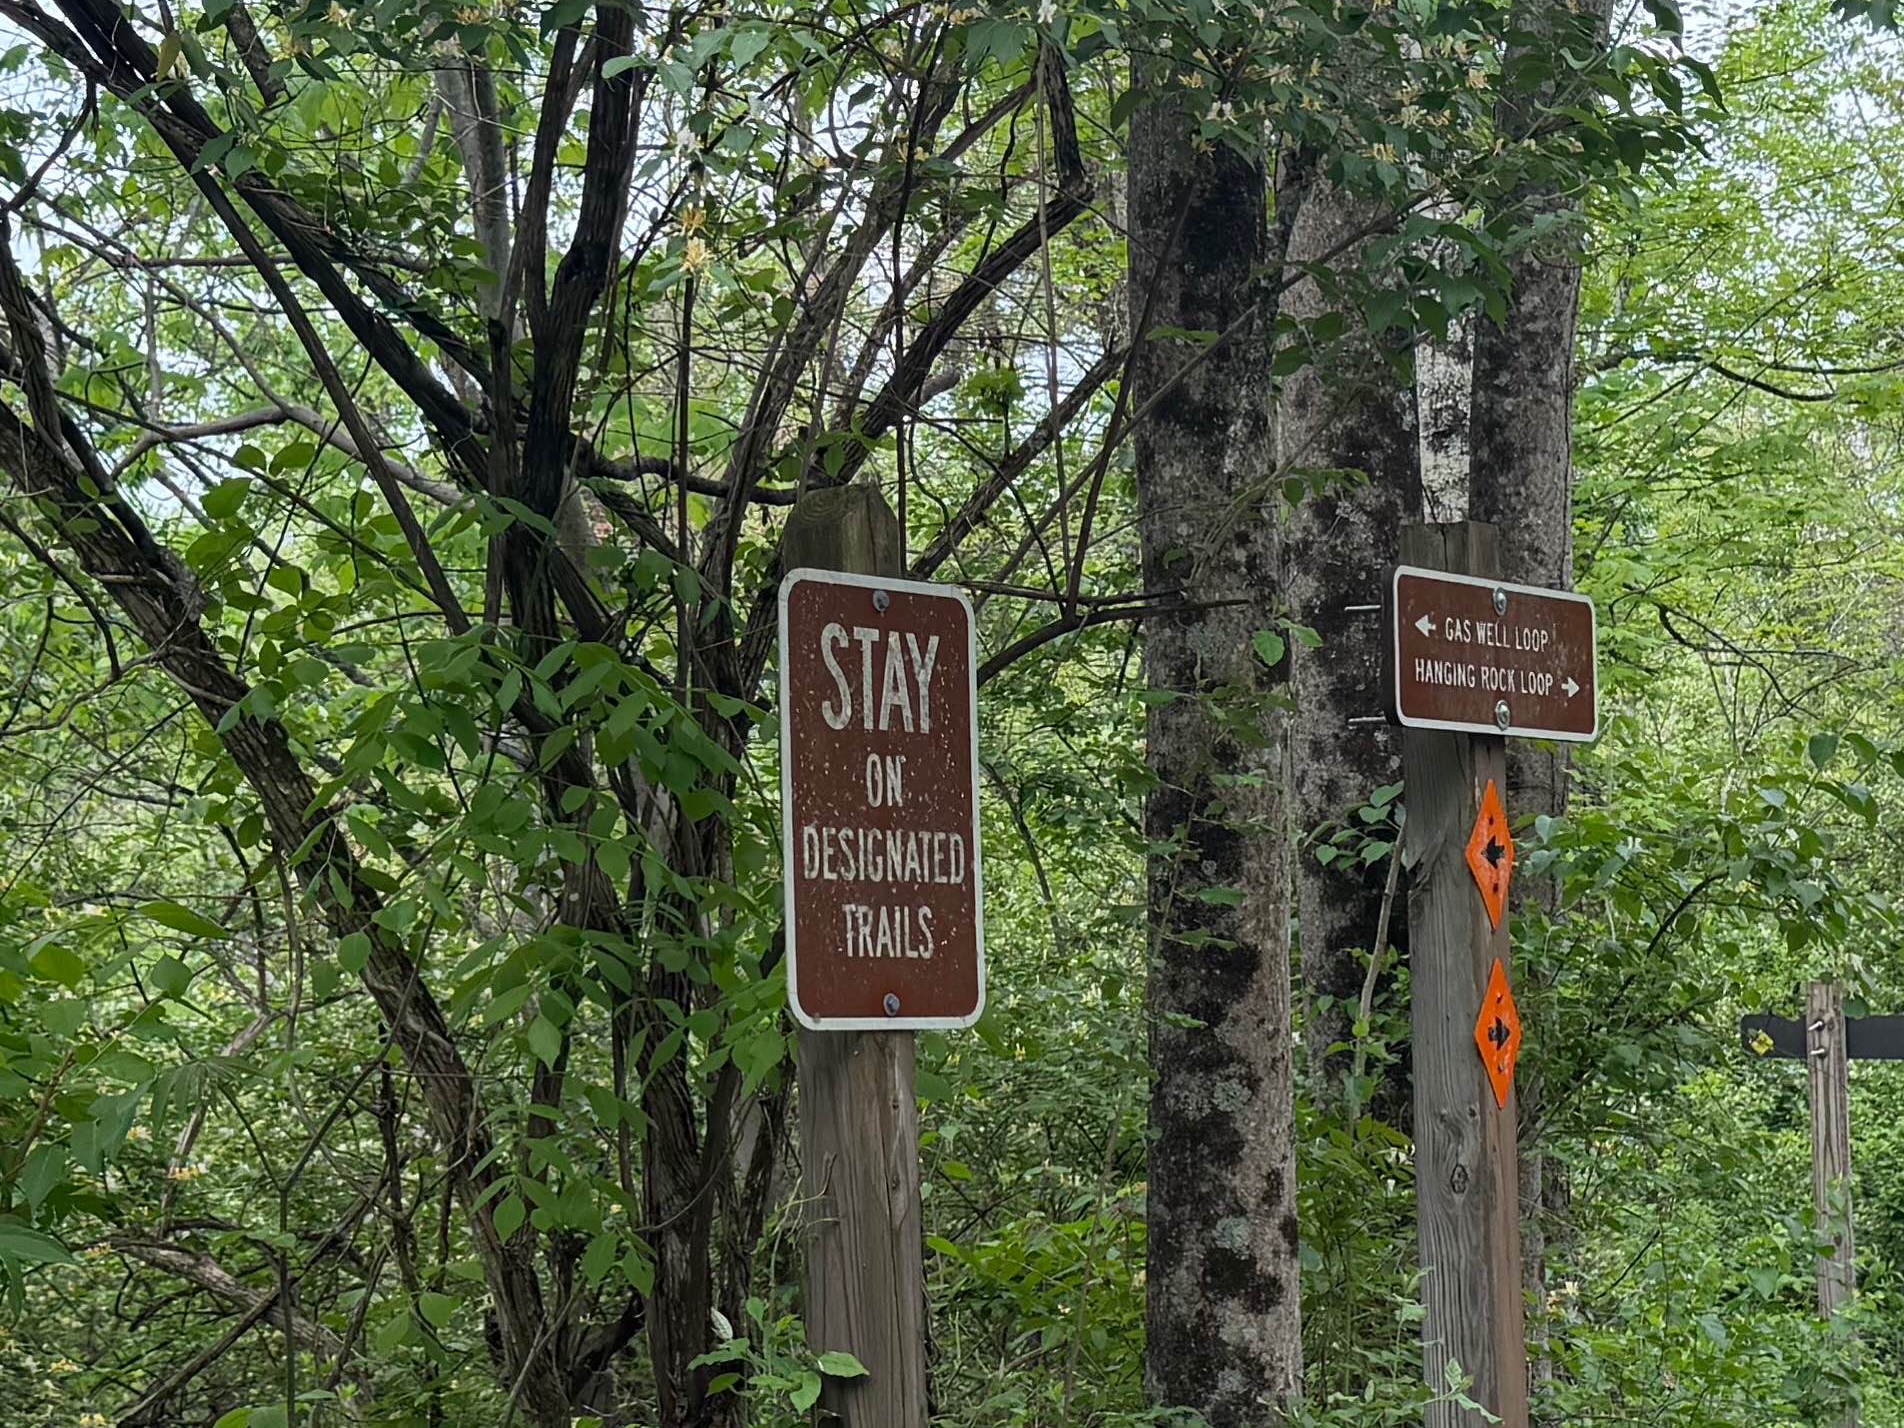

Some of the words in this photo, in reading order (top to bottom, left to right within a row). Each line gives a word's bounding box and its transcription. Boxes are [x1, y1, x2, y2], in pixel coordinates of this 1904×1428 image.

[1445, 617, 1471, 643] GAS
[1476, 621, 1510, 648] WELL
[1515, 626, 1548, 652] LOOP
[820, 622, 940, 734] STAY
[1415, 658, 1476, 688] HANGING
[1481, 665, 1515, 693] ROCK
[1521, 670, 1554, 696] LOOP
[866, 753, 904, 808] ON
[802, 825, 965, 885] DESIGNATED
[842, 903, 934, 960] TRAILS
